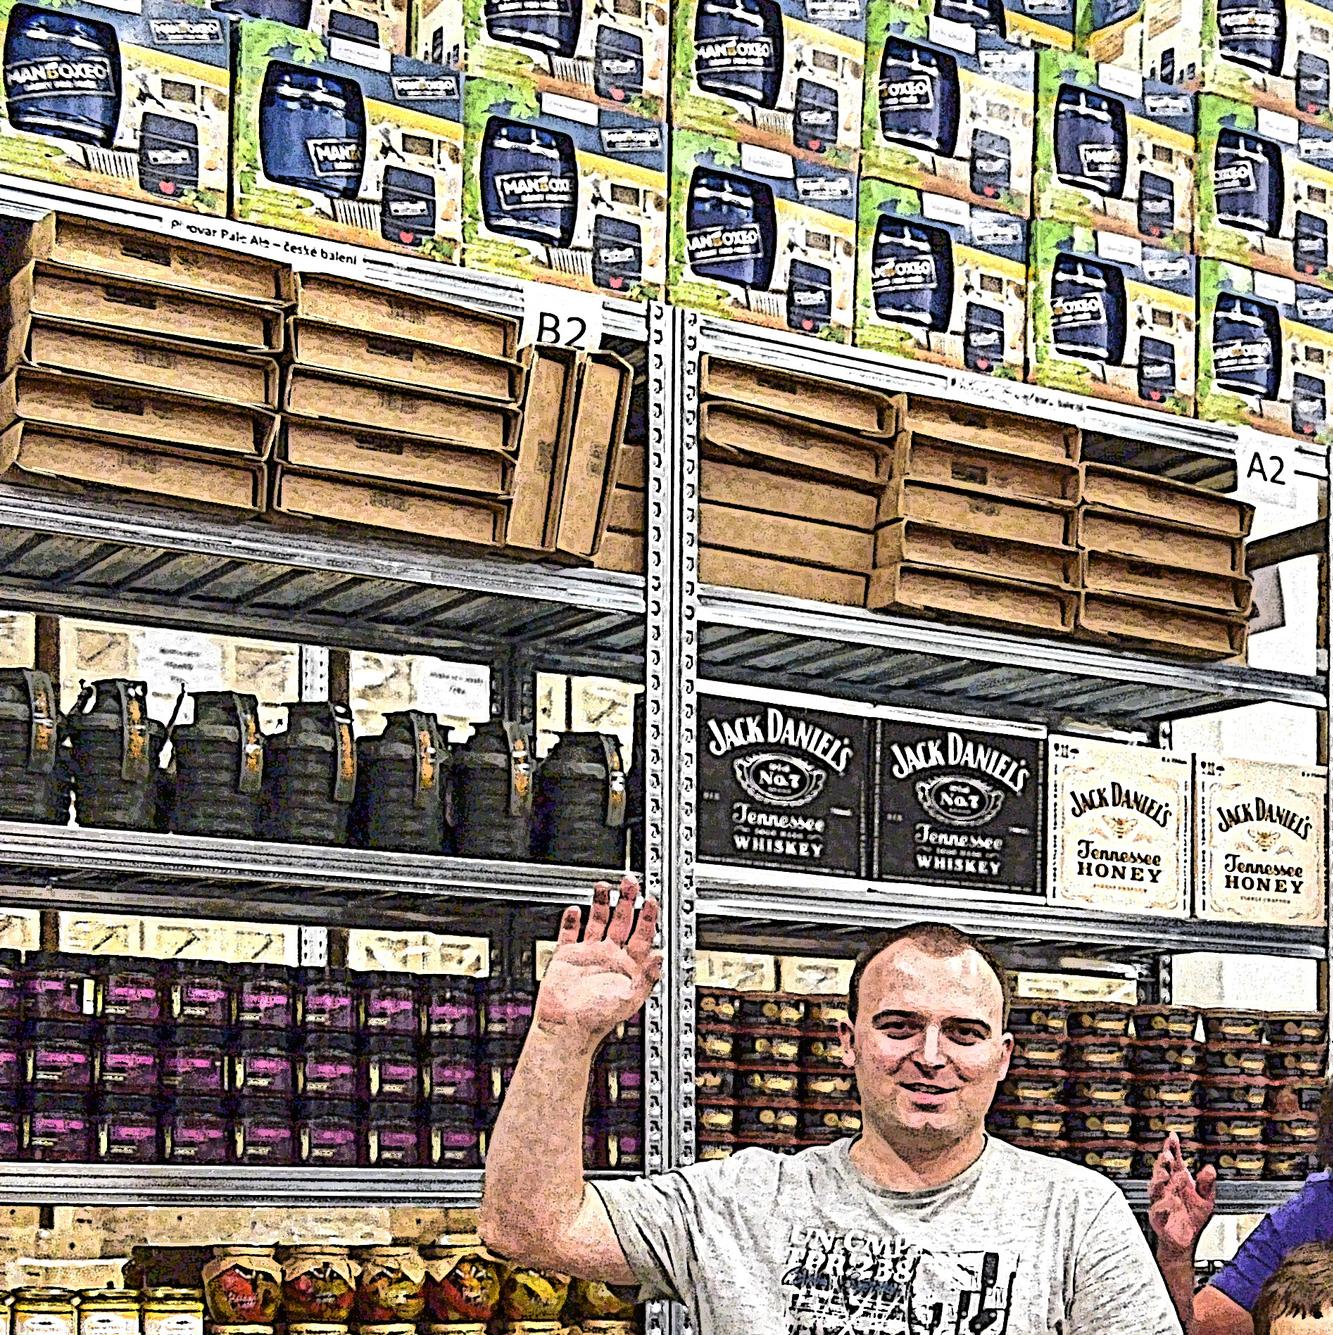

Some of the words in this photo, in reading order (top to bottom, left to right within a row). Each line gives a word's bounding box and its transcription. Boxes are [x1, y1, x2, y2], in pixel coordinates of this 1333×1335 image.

[537, 310, 588, 350] B2
[1246, 451, 1286, 486] A2
[707, 715, 765, 756] JACK
[767, 708, 854, 774] DANIEL'S
[890, 739, 945, 779] JACK
[947, 732, 1031, 795] DANIEL'S
[732, 802, 826, 832] Tennessee
[1070, 787, 1109, 818] JACK
[1111, 781, 1173, 828] DANIEL'S
[1216, 802, 1254, 833] JACK
[1255, 796, 1313, 840] DANIEL'S
[733, 834, 824, 858] WHISKEY
[914, 823, 1004, 849] Tennessee
[915, 853, 1002, 876] WHISKEY
[1077, 839, 1162, 866] Tennessee
[1224, 853, 1304, 878] Tennessee
[1077, 861, 1163, 883] HONEY
[1224, 874, 1305, 895] HONEY
